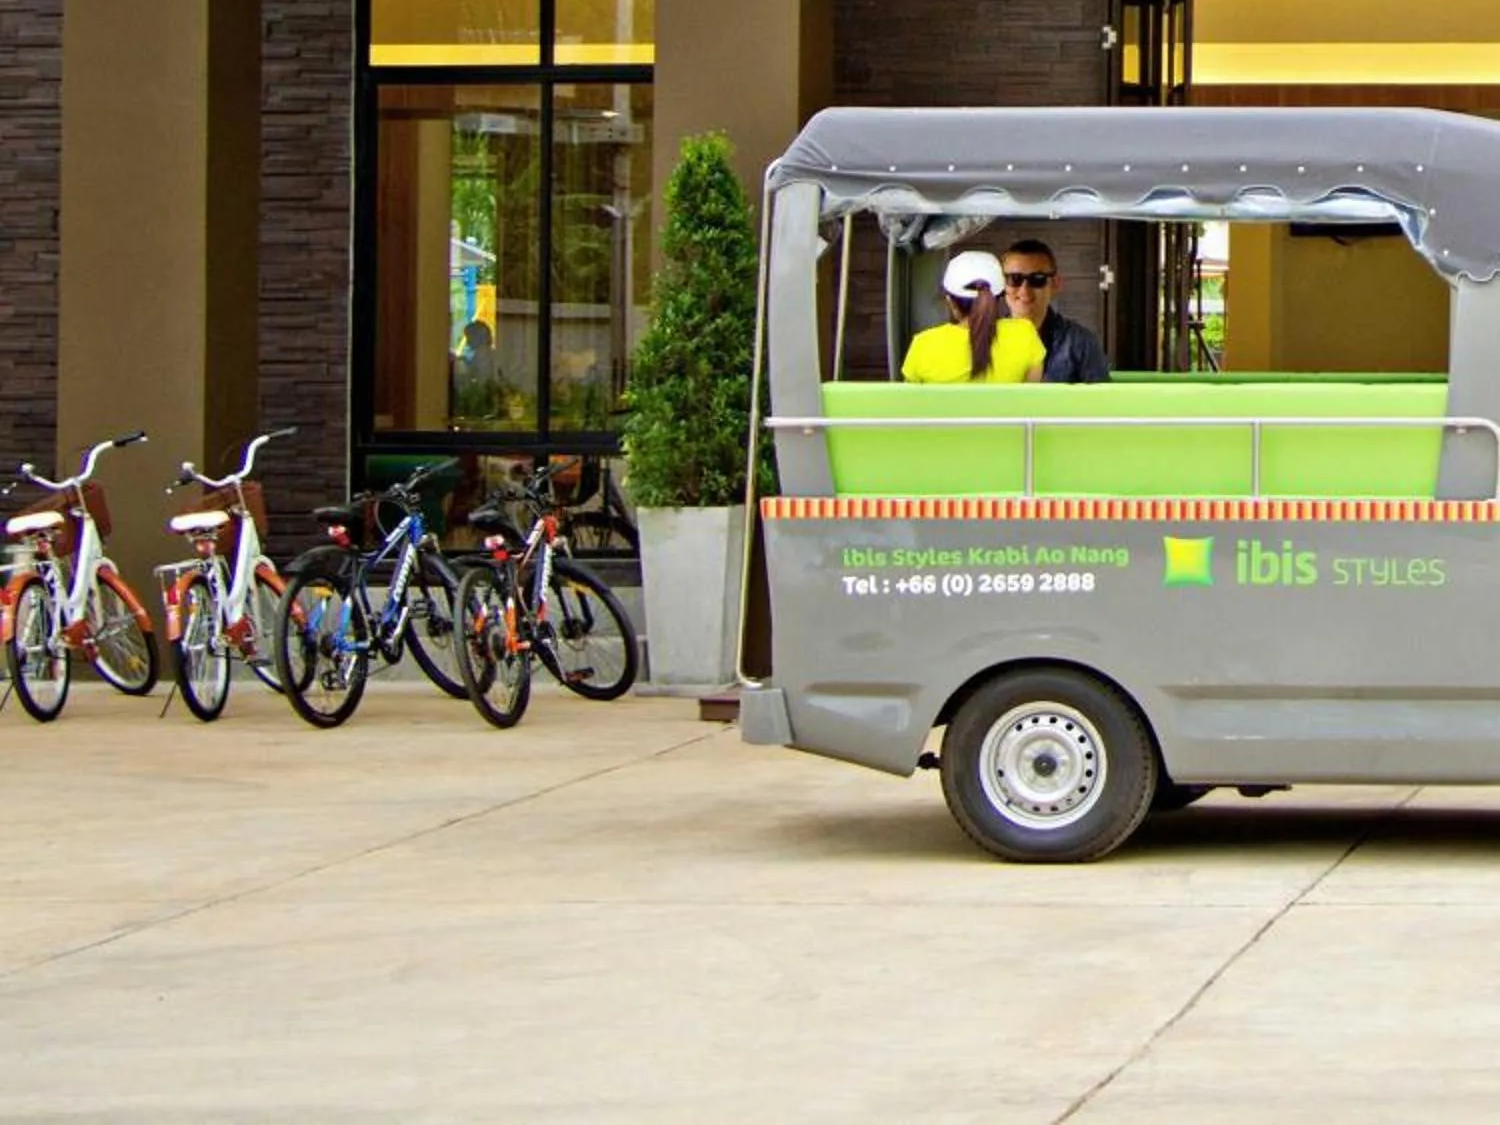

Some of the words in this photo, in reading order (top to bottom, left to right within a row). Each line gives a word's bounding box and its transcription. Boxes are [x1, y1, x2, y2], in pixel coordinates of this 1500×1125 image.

[842, 548, 887, 567] ibis
[892, 547, 963, 568] Styles
[968, 545, 1029, 566] Krabi
[1035, 546, 1065, 565] Ao
[1070, 544, 1130, 567] Nang
[1235, 539, 1318, 586] ibis
[842, 575, 878, 595] Tel
[895, 575, 937, 594] +66
[941, 574, 973, 596] (0)
[978, 573, 1035, 592] 2659
[1039, 572, 1096, 592] 2888
